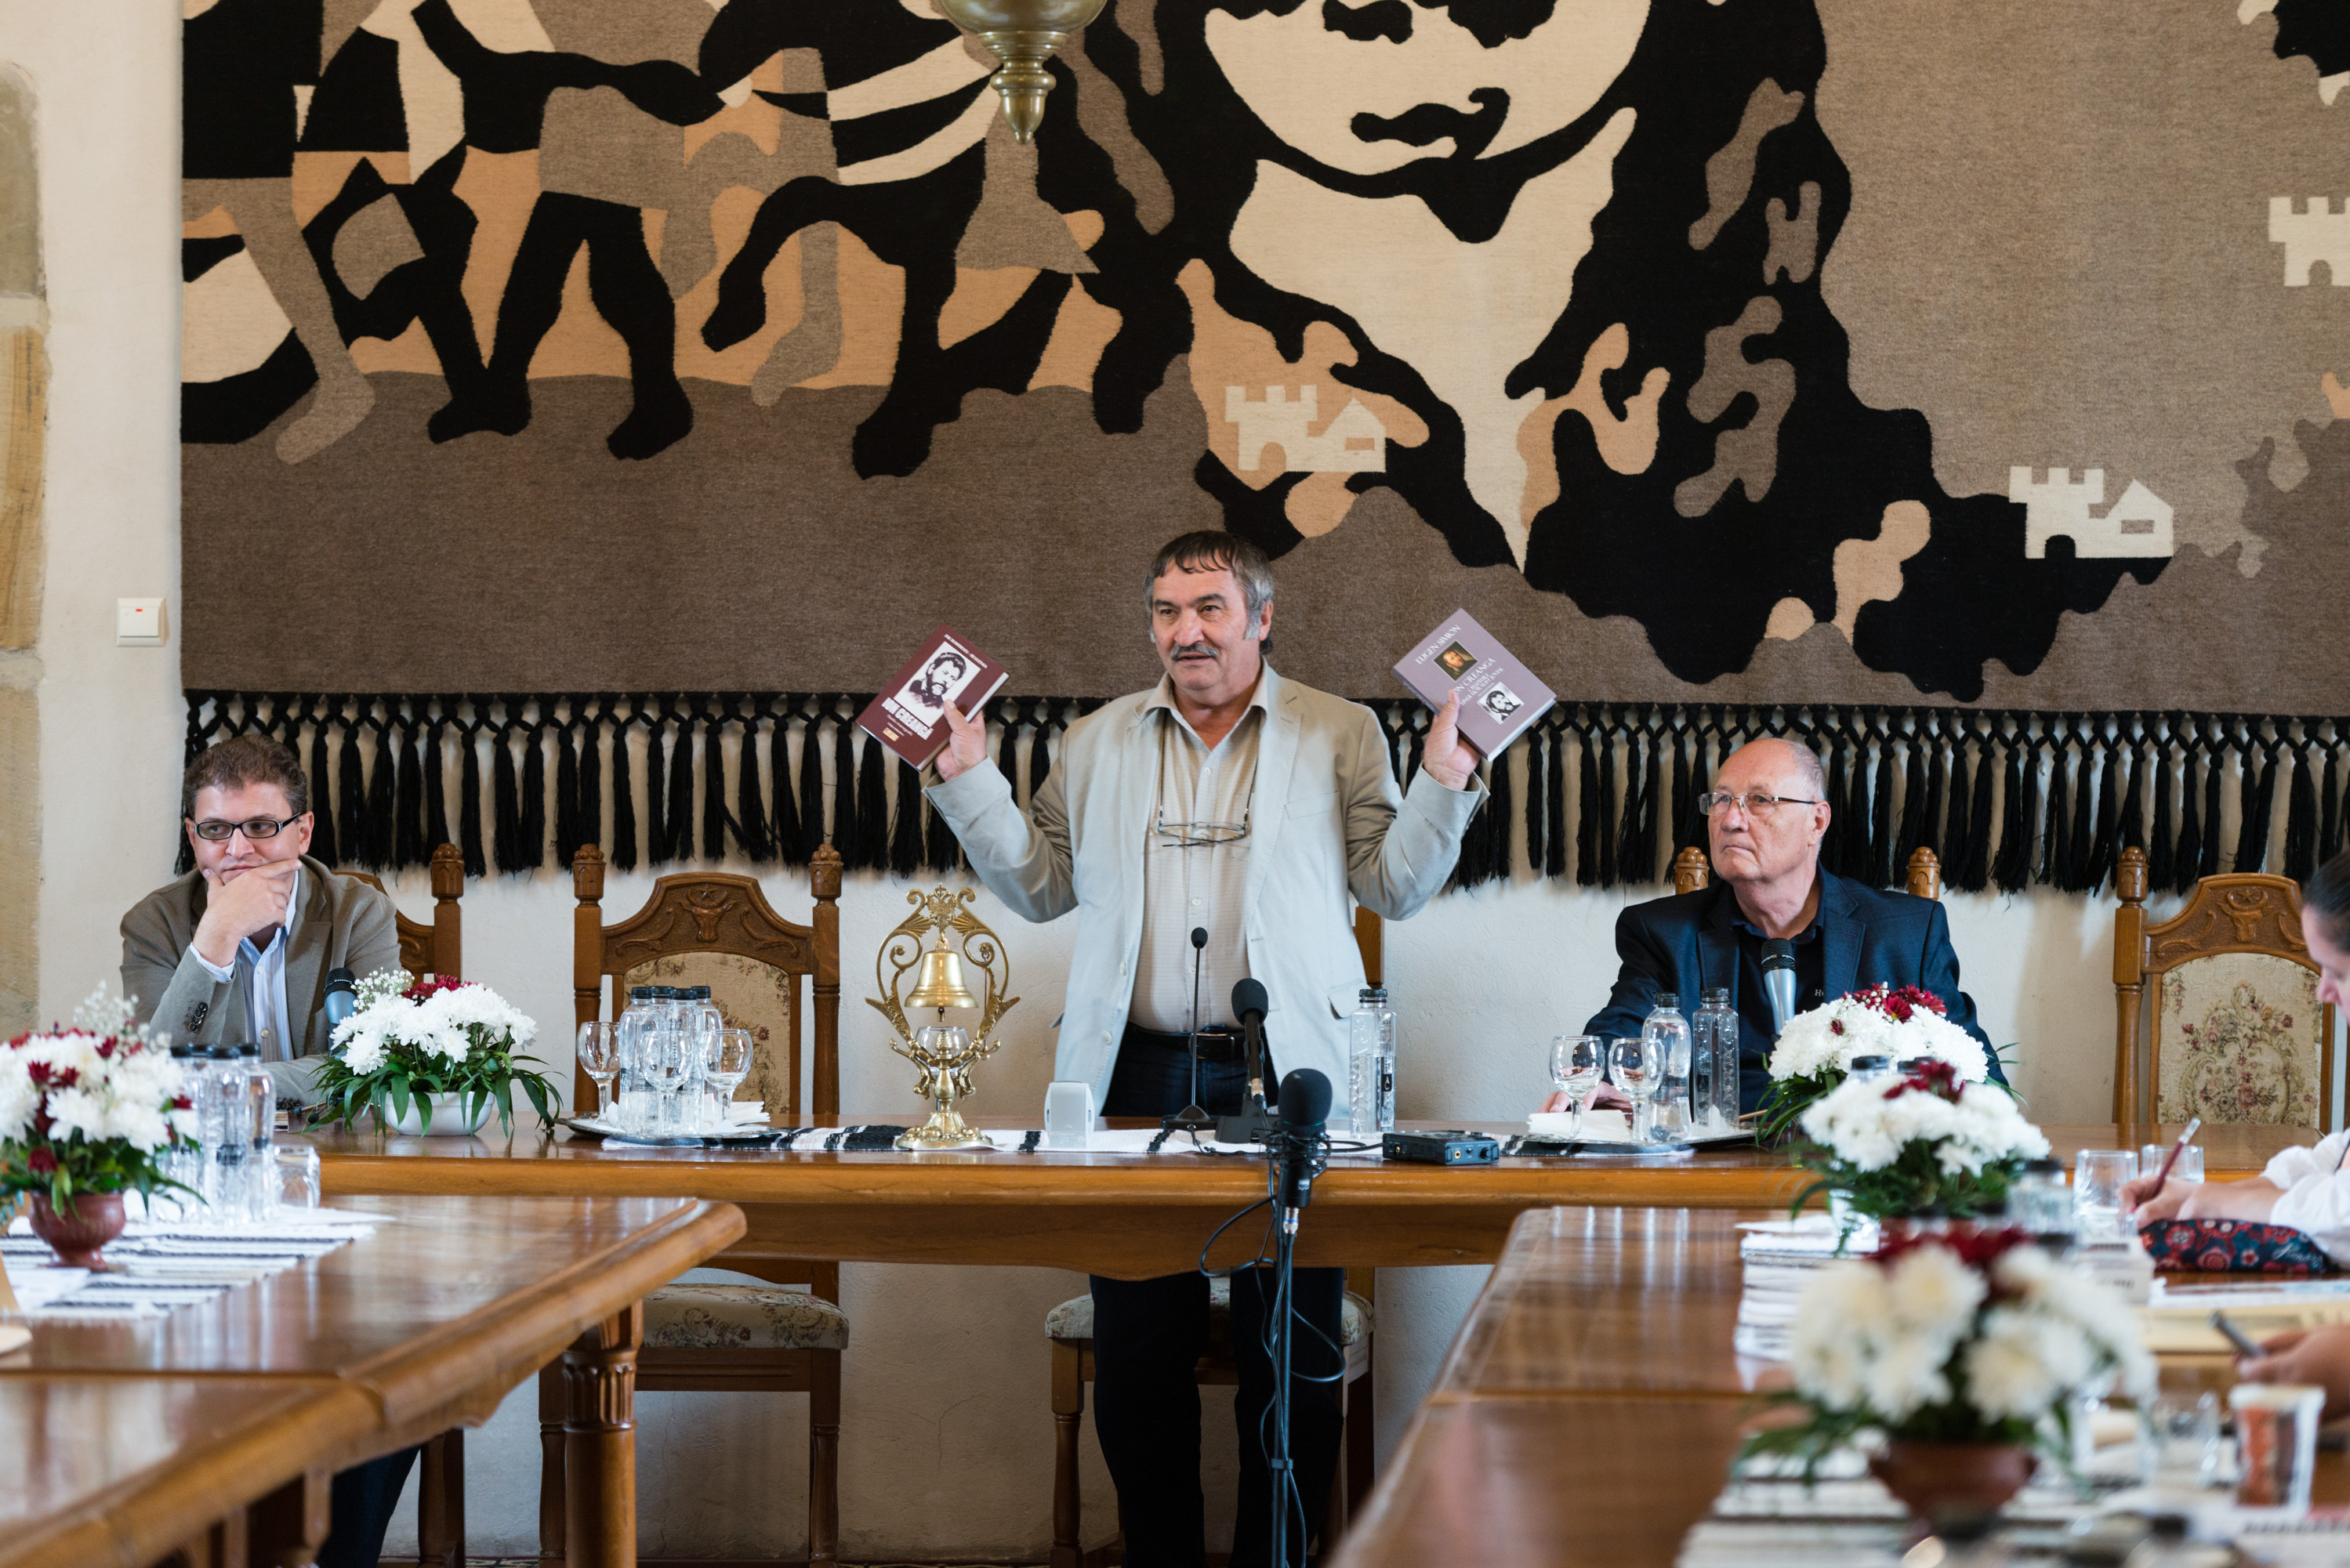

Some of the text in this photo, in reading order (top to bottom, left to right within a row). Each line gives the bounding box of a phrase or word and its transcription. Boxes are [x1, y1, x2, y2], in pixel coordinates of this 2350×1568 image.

[1415, 624, 1461, 665] EUGEN SIMION
[881, 697, 901, 715] ION
